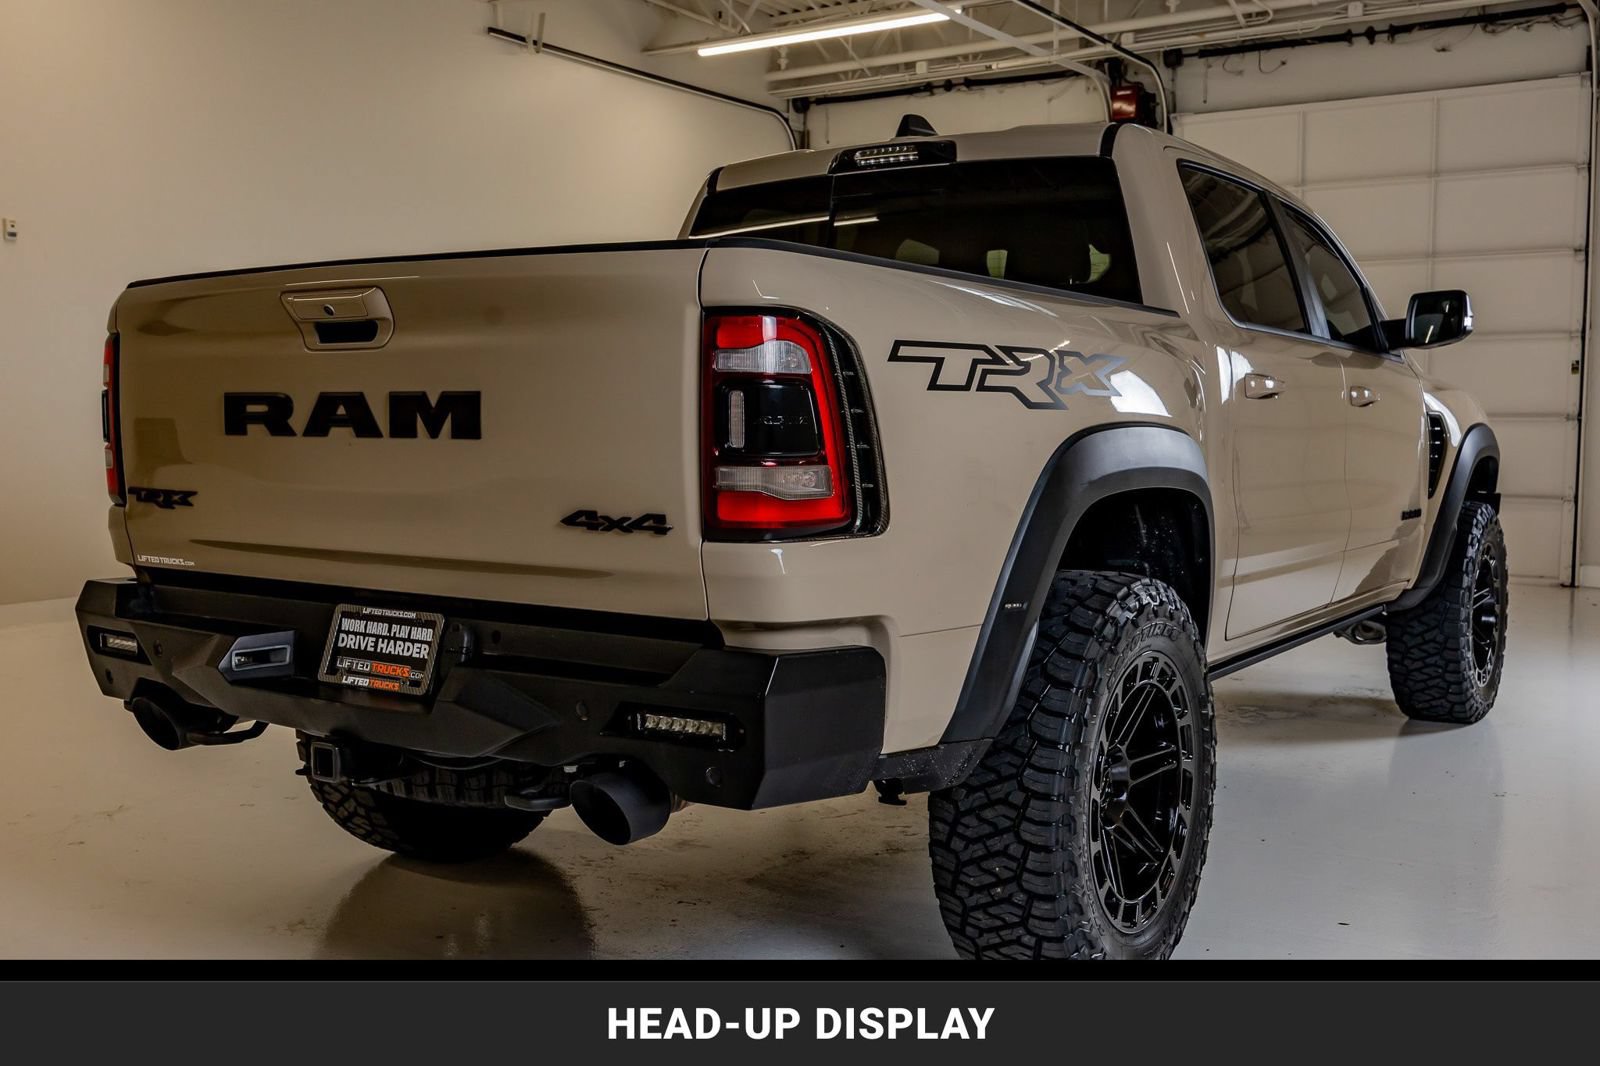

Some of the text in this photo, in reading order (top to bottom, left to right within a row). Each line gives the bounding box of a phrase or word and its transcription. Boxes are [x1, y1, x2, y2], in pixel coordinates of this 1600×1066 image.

[887, 339, 1128, 410] TRX
[224, 391, 482, 440] RAM
[560, 509, 674, 535] 4x4
[341, 618, 366, 632] WORK
[391, 624, 410, 638] PLAY
[338, 634, 429, 658] DRIVE HARDER
[336, 658, 370, 671] LIFTED
[342, 676, 399, 690] LIFTED TRUCKS
